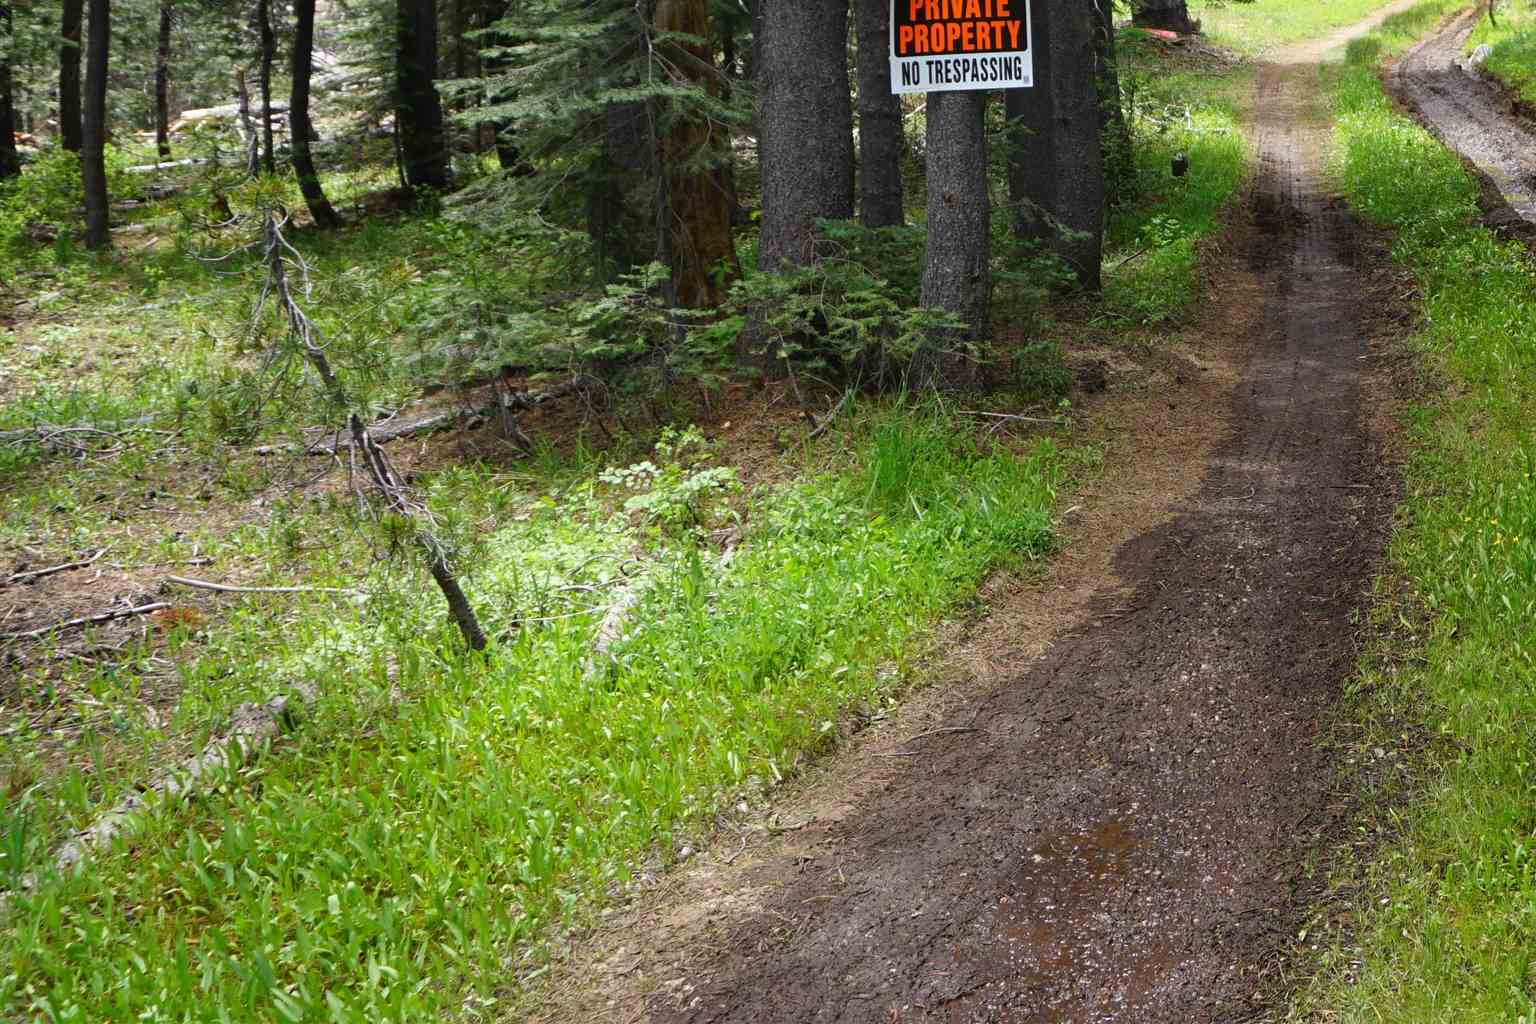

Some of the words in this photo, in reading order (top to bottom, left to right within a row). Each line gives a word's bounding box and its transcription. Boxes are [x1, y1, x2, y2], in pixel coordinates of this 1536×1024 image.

[899, 20, 1022, 54] PROPERTY
[901, 61, 920, 86] NO
[926, 56, 1022, 84] TRESPASSING
